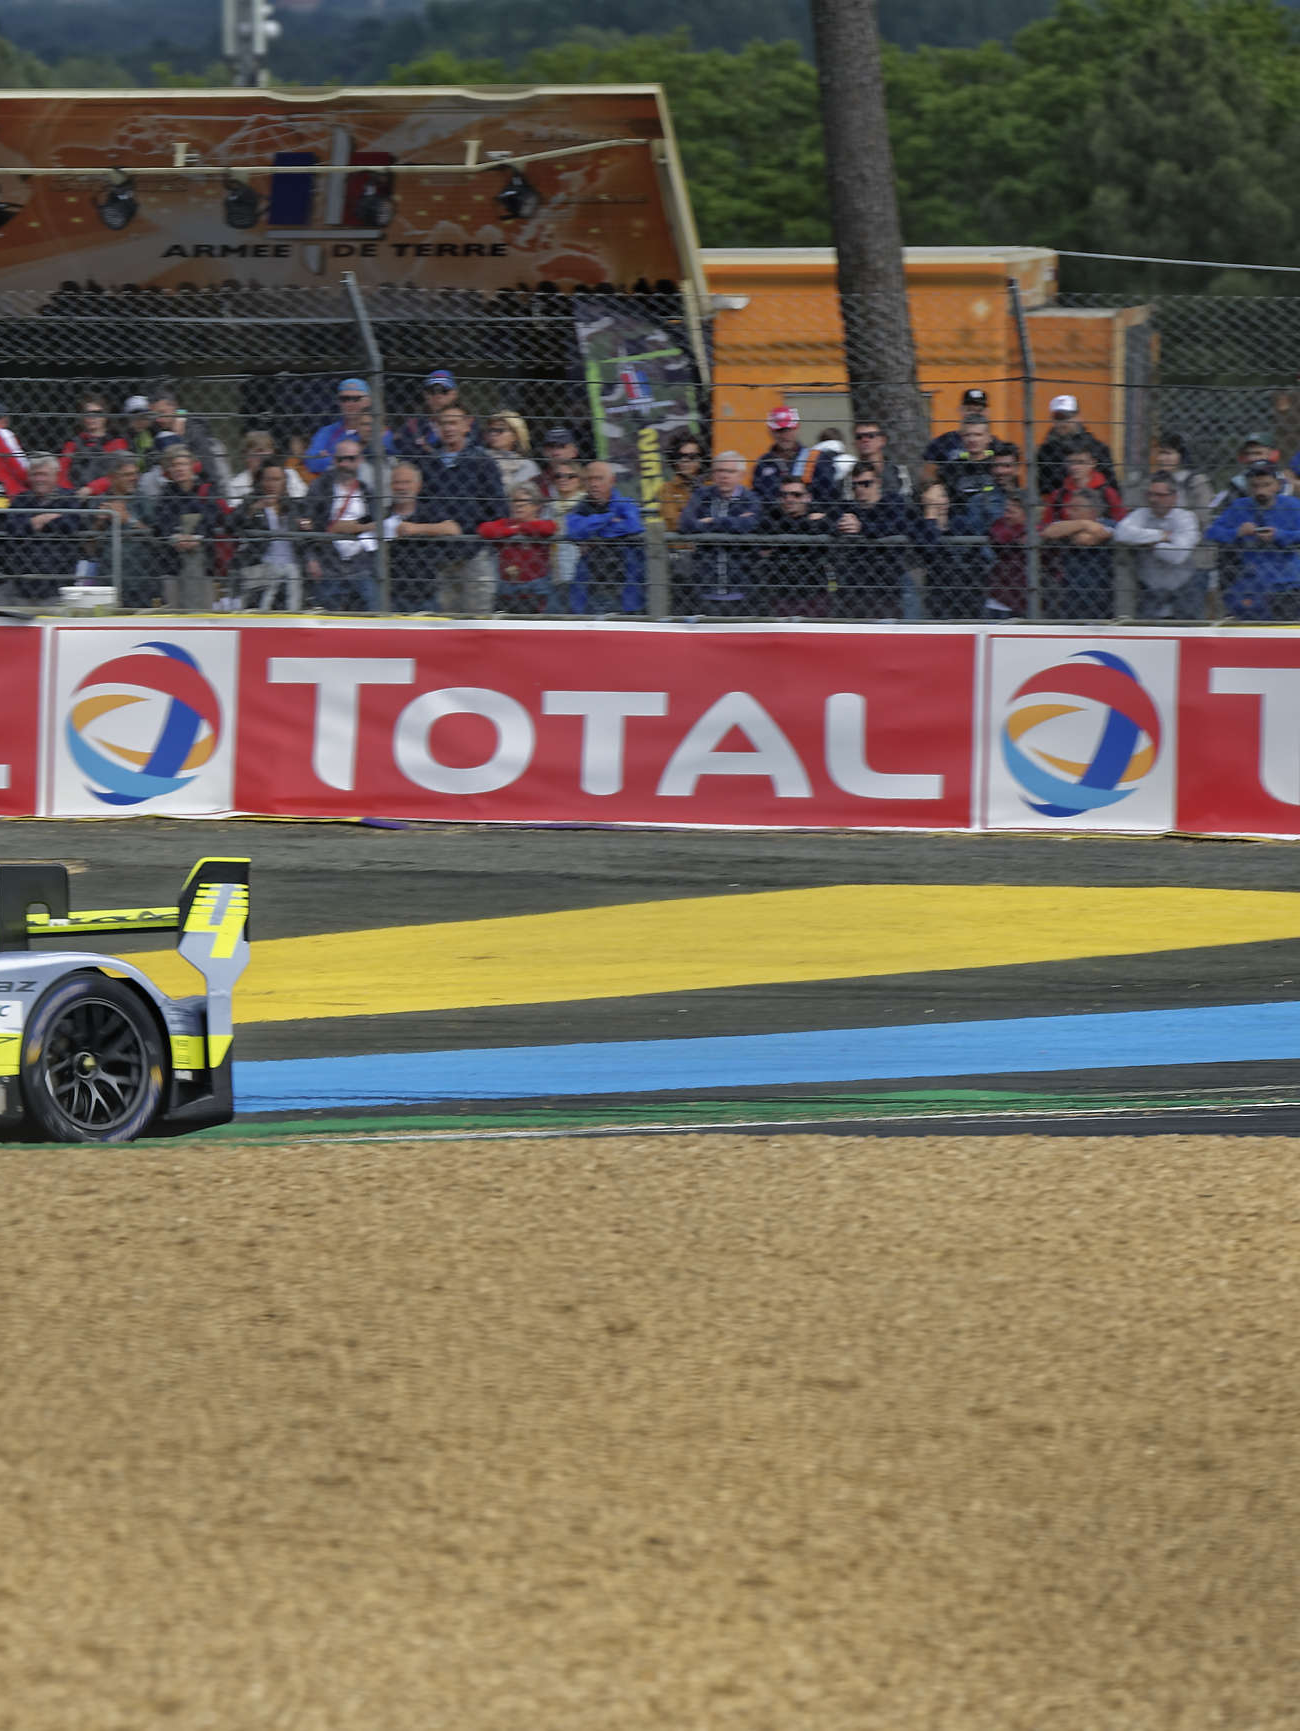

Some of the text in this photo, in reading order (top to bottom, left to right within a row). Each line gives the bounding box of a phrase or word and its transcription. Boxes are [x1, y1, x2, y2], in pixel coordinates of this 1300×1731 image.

[160, 242, 509, 259] ARMEE DE TERRE
[267, 657, 944, 800] TOTAL
